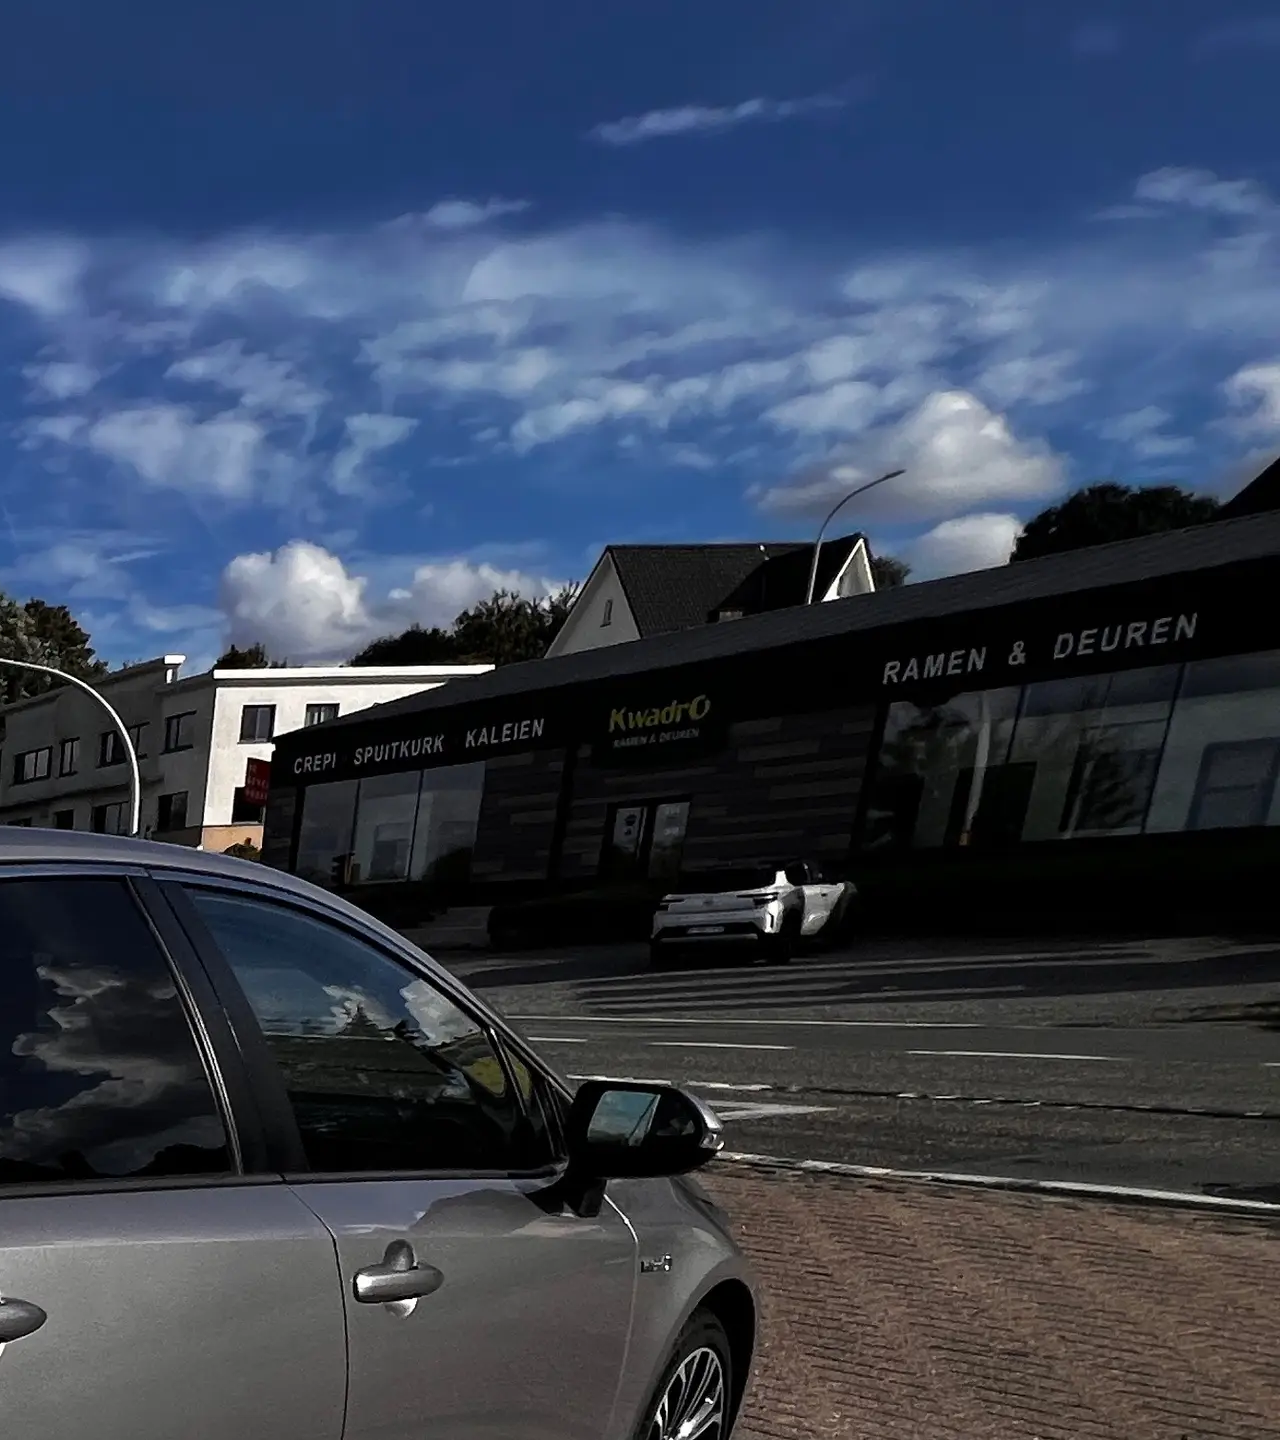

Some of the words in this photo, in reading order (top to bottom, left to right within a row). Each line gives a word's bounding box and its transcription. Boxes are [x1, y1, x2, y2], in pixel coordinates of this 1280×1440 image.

[882, 647, 987, 685] RAMEN
[1007, 640, 1027, 666] &
[1053, 612, 1198, 660] DEUREN
[293, 753, 337, 774] CREPI
[353, 735, 445, 765] SPUITKURK
[465, 718, 545, 748] KALEIEN
